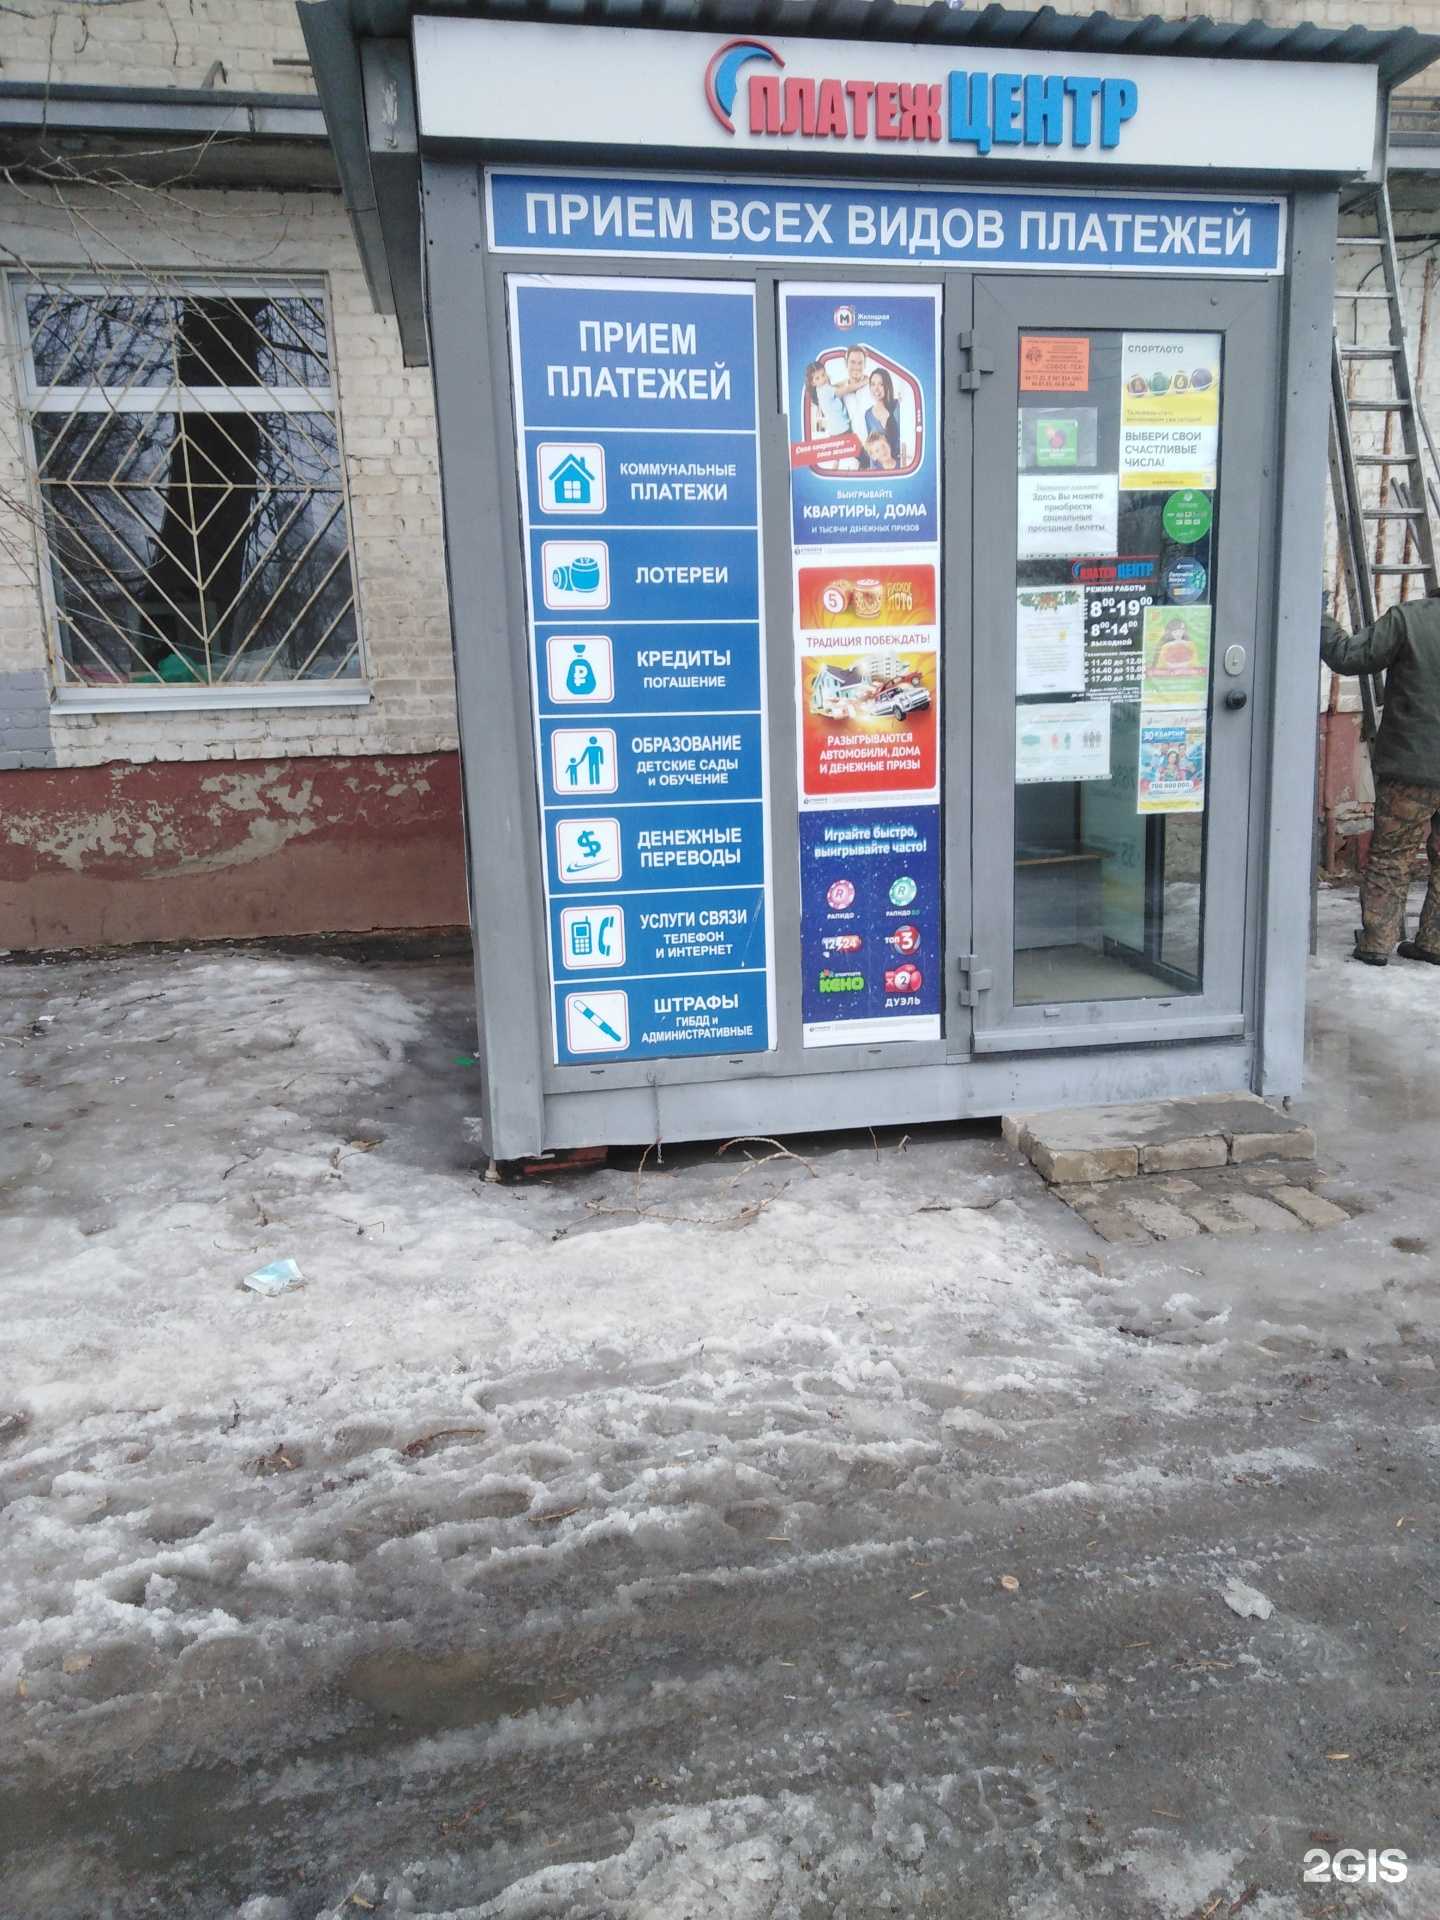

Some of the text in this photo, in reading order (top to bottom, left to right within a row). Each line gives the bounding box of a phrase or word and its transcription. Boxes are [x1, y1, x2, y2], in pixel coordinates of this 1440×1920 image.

[525, 191, 1251, 256] ПРИЕМ ВСЕХ ВИДОВ ПЛАТЕЖЕЙ
[579, 320, 696, 355] ПРИЕМ
[547, 362, 731, 401] ПЛАТЕЖЕЙ
[1125, 431, 1169, 441] ВЫБЕРИ
[1125, 444, 1198, 454] СЧАСТЛИВЫЕ
[619, 463, 737, 477] КОММУНАЛЬНЫЕ
[1124, 457, 1166, 467] ЧИСЛА!
[631, 483, 728, 501] ПЛАТЕЖИ
[803, 503, 928, 519] КВАРТИРЫ, ДОМА
[635, 566, 729, 585] ЛОТЕРЕИ
[1115, 584, 1146, 592] РАБОТЫ
[806, 633, 930, 649] ТРАДИЦИЯ ПОБЕЖДАТЬ!
[636, 649, 732, 671] КРЕДИТЫ
[643, 676, 726, 689] ПОГАШЕНИЕ
[631, 734, 742, 754] ОБРАЗОВАНИЕ
[827, 732, 913, 746] РАЗЫГРЫВАЮТСЯ
[891, 746, 920, 759] ДОМА
[636, 758, 739, 774] ДЕТСКИЕ САДЫ
[819, 759, 920, 775] И ДЕНЕЖНЫЕ ПРИЗЫ
[659, 773, 729, 786] ОБУЧЕНИЕ
[637, 827, 742, 848] ДЕНЕЖНЫЕ
[824, 826, 918, 842] Играйте быстро,
[814, 839, 927, 858] выигрывайте часто!
[639, 848, 742, 869] ПЕРЕВОДЫ
[639, 908, 747, 930] УСЛУГИ СВЯЗИ
[663, 931, 725, 945] ТЕЛЕФОН
[901, 931, 914, 950] 3
[655, 944, 733, 958] И ИНТЕРНЕТ
[819, 976, 865, 993] КЕНО
[653, 993, 739, 1014] ШТРАФЫ
[884, 996, 921, 1008] ДУЭЛЬ
[675, 1015, 710, 1028] ГИБДД
[641, 1024, 753, 1043] АДМИНИСТРАТИВНЫЕ
